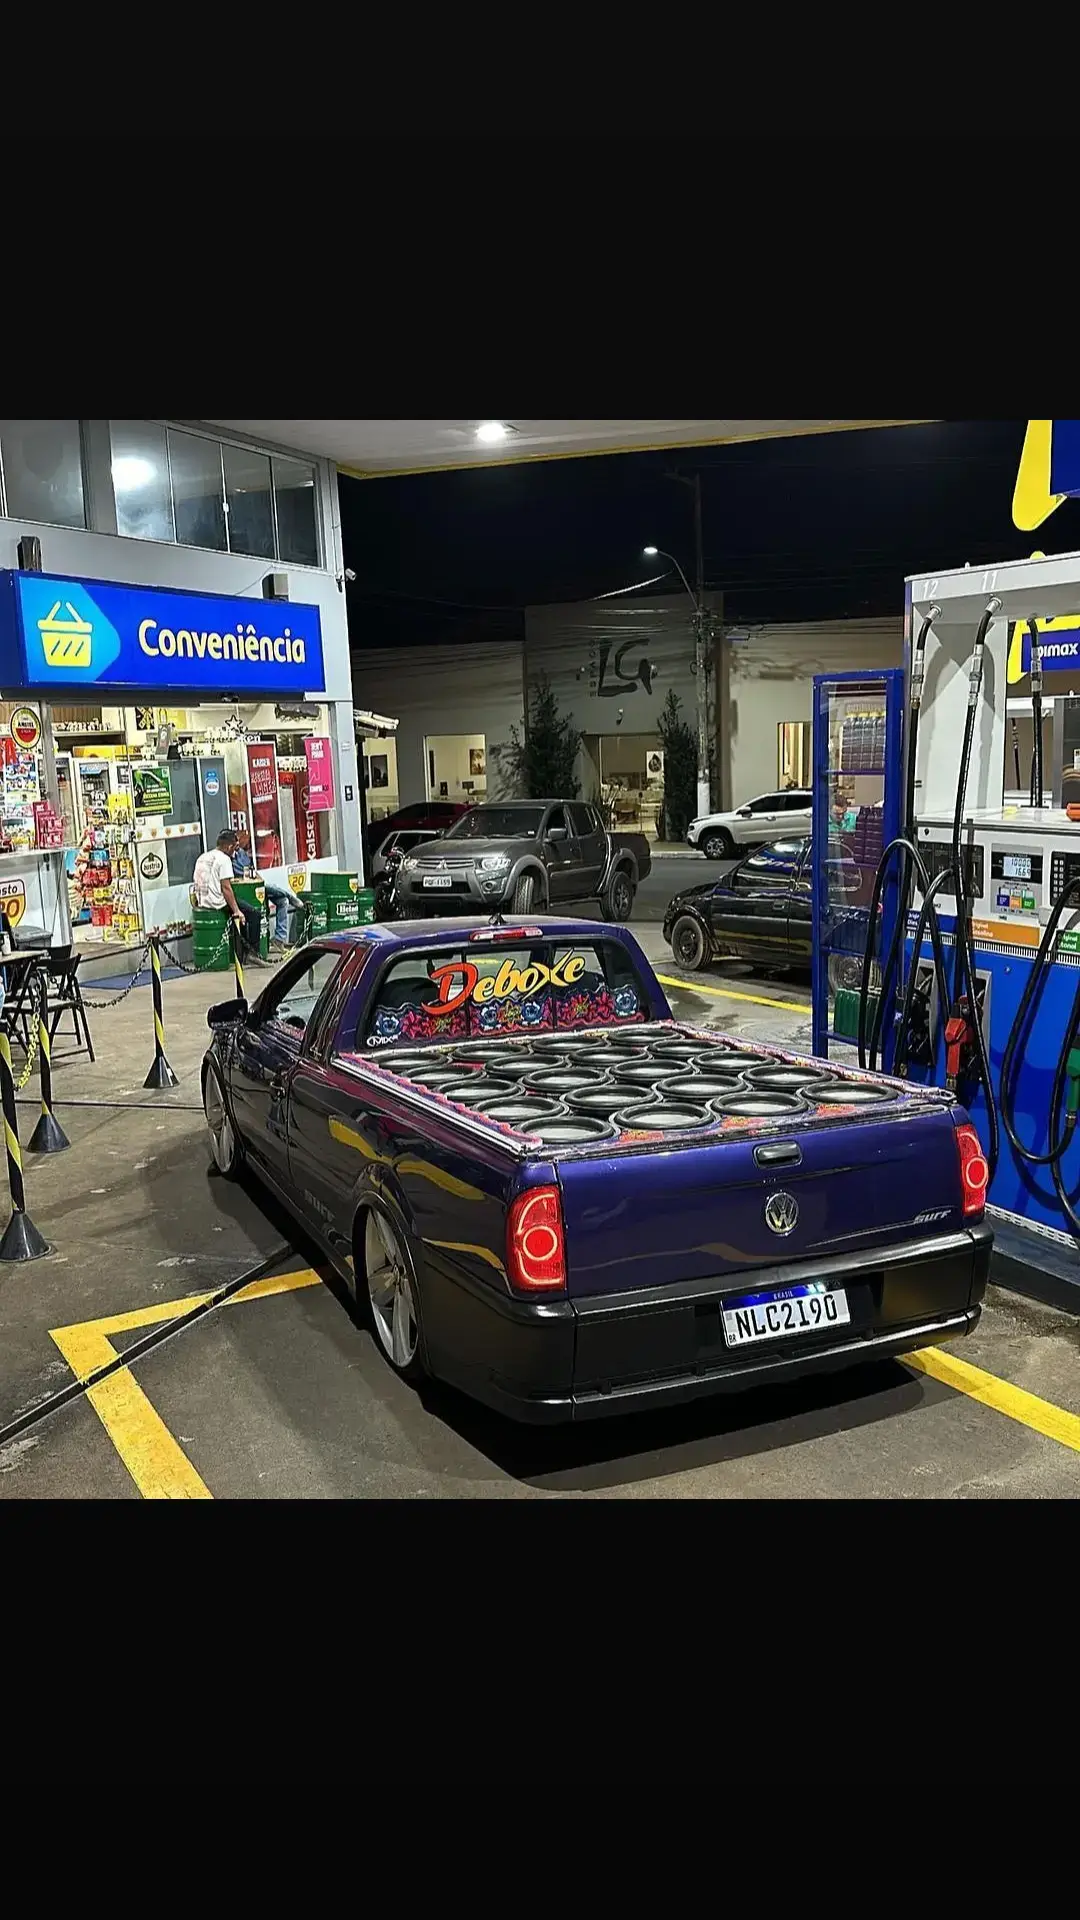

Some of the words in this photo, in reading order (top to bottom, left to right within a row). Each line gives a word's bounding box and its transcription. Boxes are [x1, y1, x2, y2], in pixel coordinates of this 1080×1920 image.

[923, 580, 939, 600] 12
[982, 570, 998, 592] 11
[138, 619, 306, 663] Conveniência
[0, 884, 18, 896] sto
[292, 875, 305, 888] 20
[773, 1290, 794, 1300] BRASIL
[735, 1294, 838, 1339] NLC2I90
